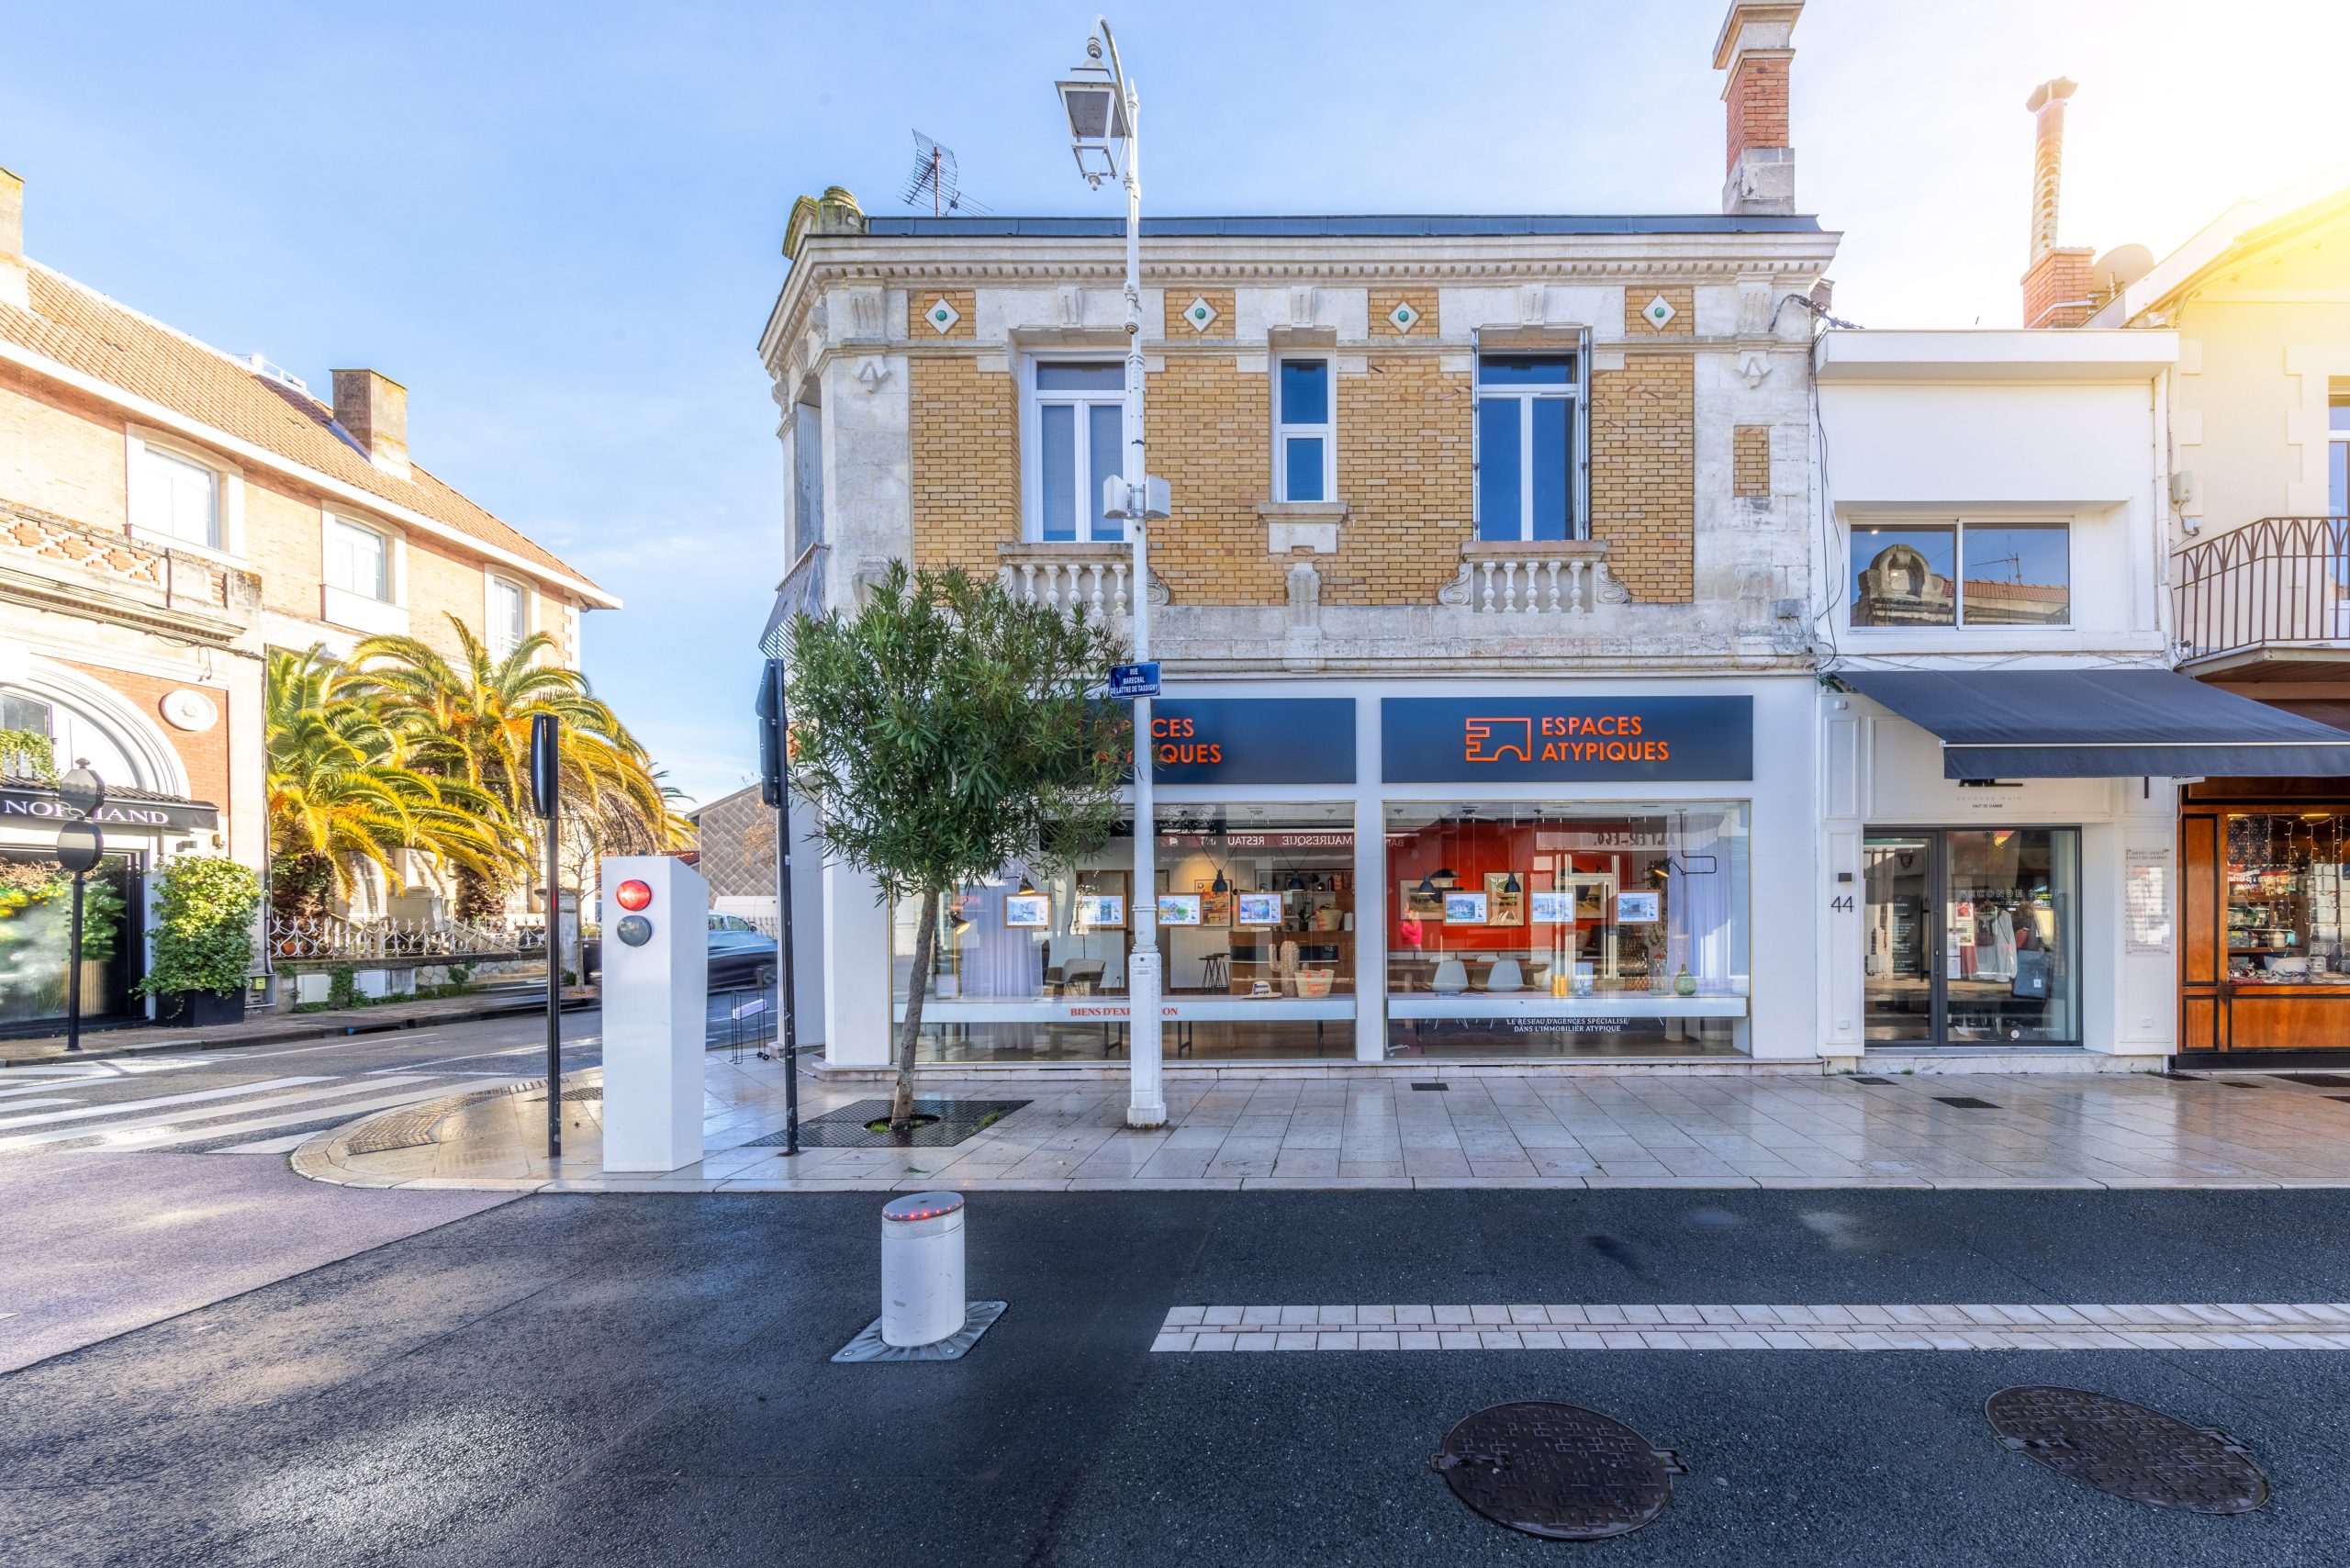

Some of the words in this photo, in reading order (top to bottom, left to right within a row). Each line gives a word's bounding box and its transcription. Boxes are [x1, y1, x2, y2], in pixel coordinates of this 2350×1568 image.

[1129, 667, 1138, 676] RUE
[1138, 684, 1158, 692] TASSIGNY
[1541, 715, 1642, 736] ESPACES
[1541, 741, 1670, 761] ATYPIQUES
[1831, 896, 1854, 913] 44
[1070, 1007, 1101, 1016] BIENS
